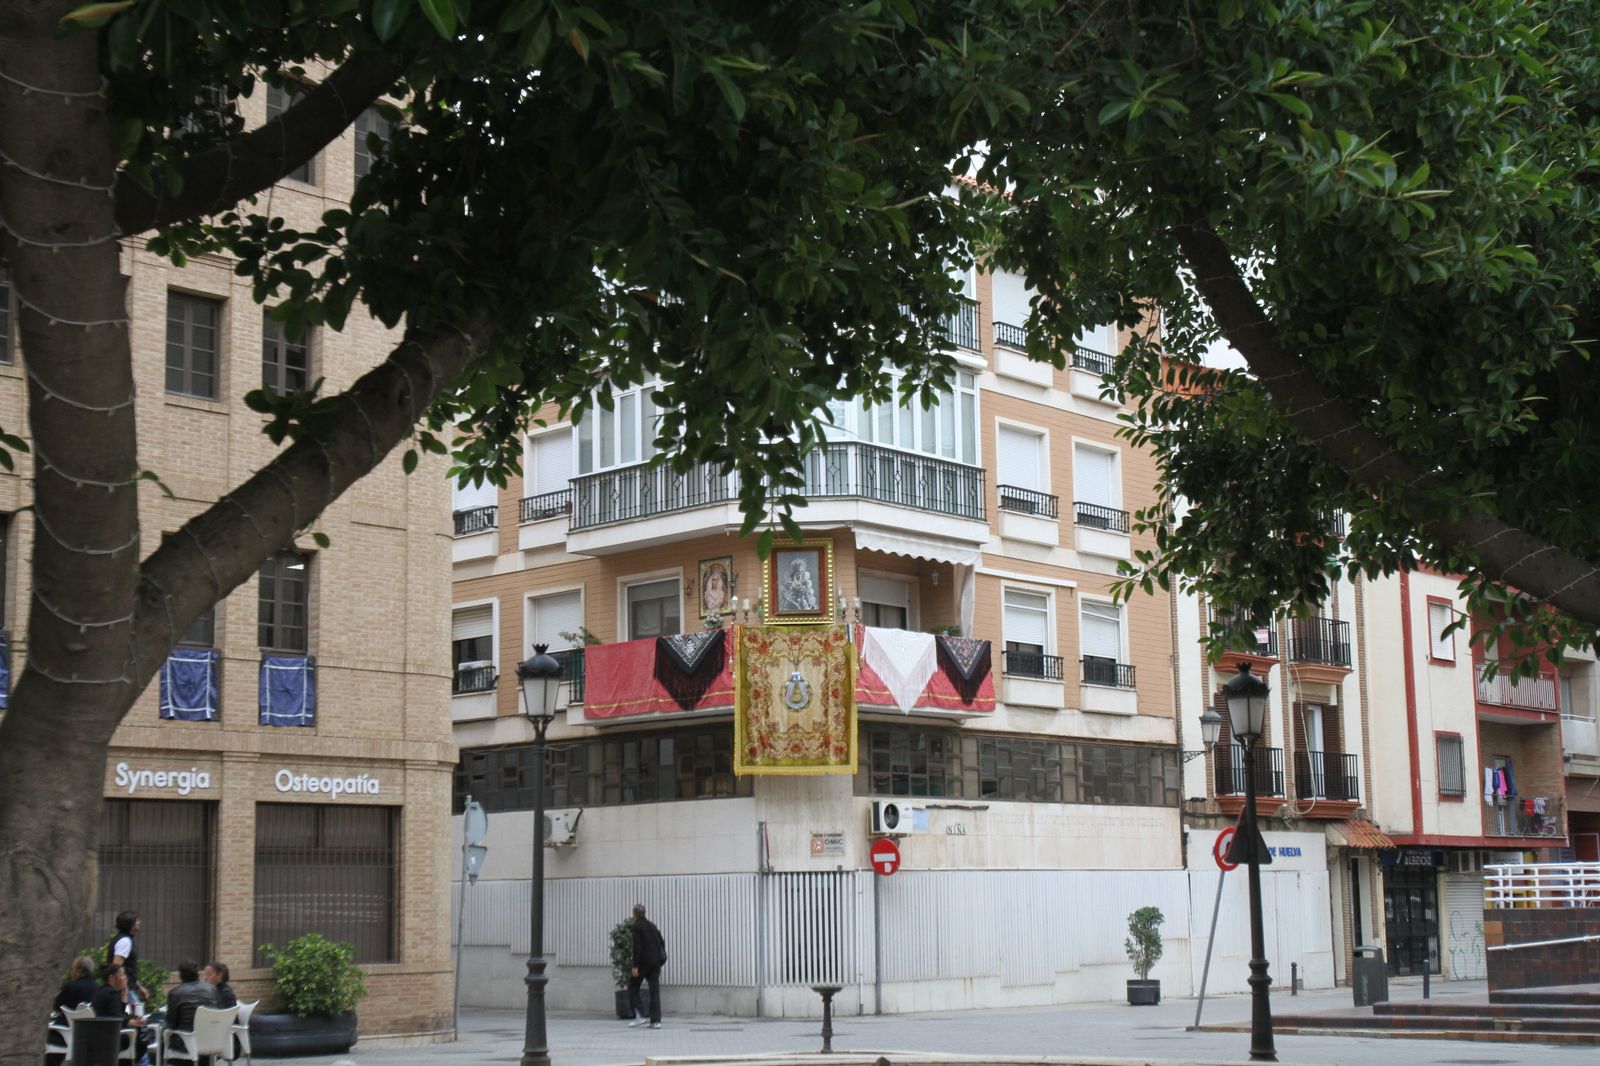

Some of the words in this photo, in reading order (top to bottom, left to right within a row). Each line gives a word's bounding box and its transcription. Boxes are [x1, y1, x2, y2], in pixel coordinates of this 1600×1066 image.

[115, 763, 209, 795] Synergia
[275, 769, 380, 799] Osteopatía
[1279, 847, 1302, 857] HUELVA
